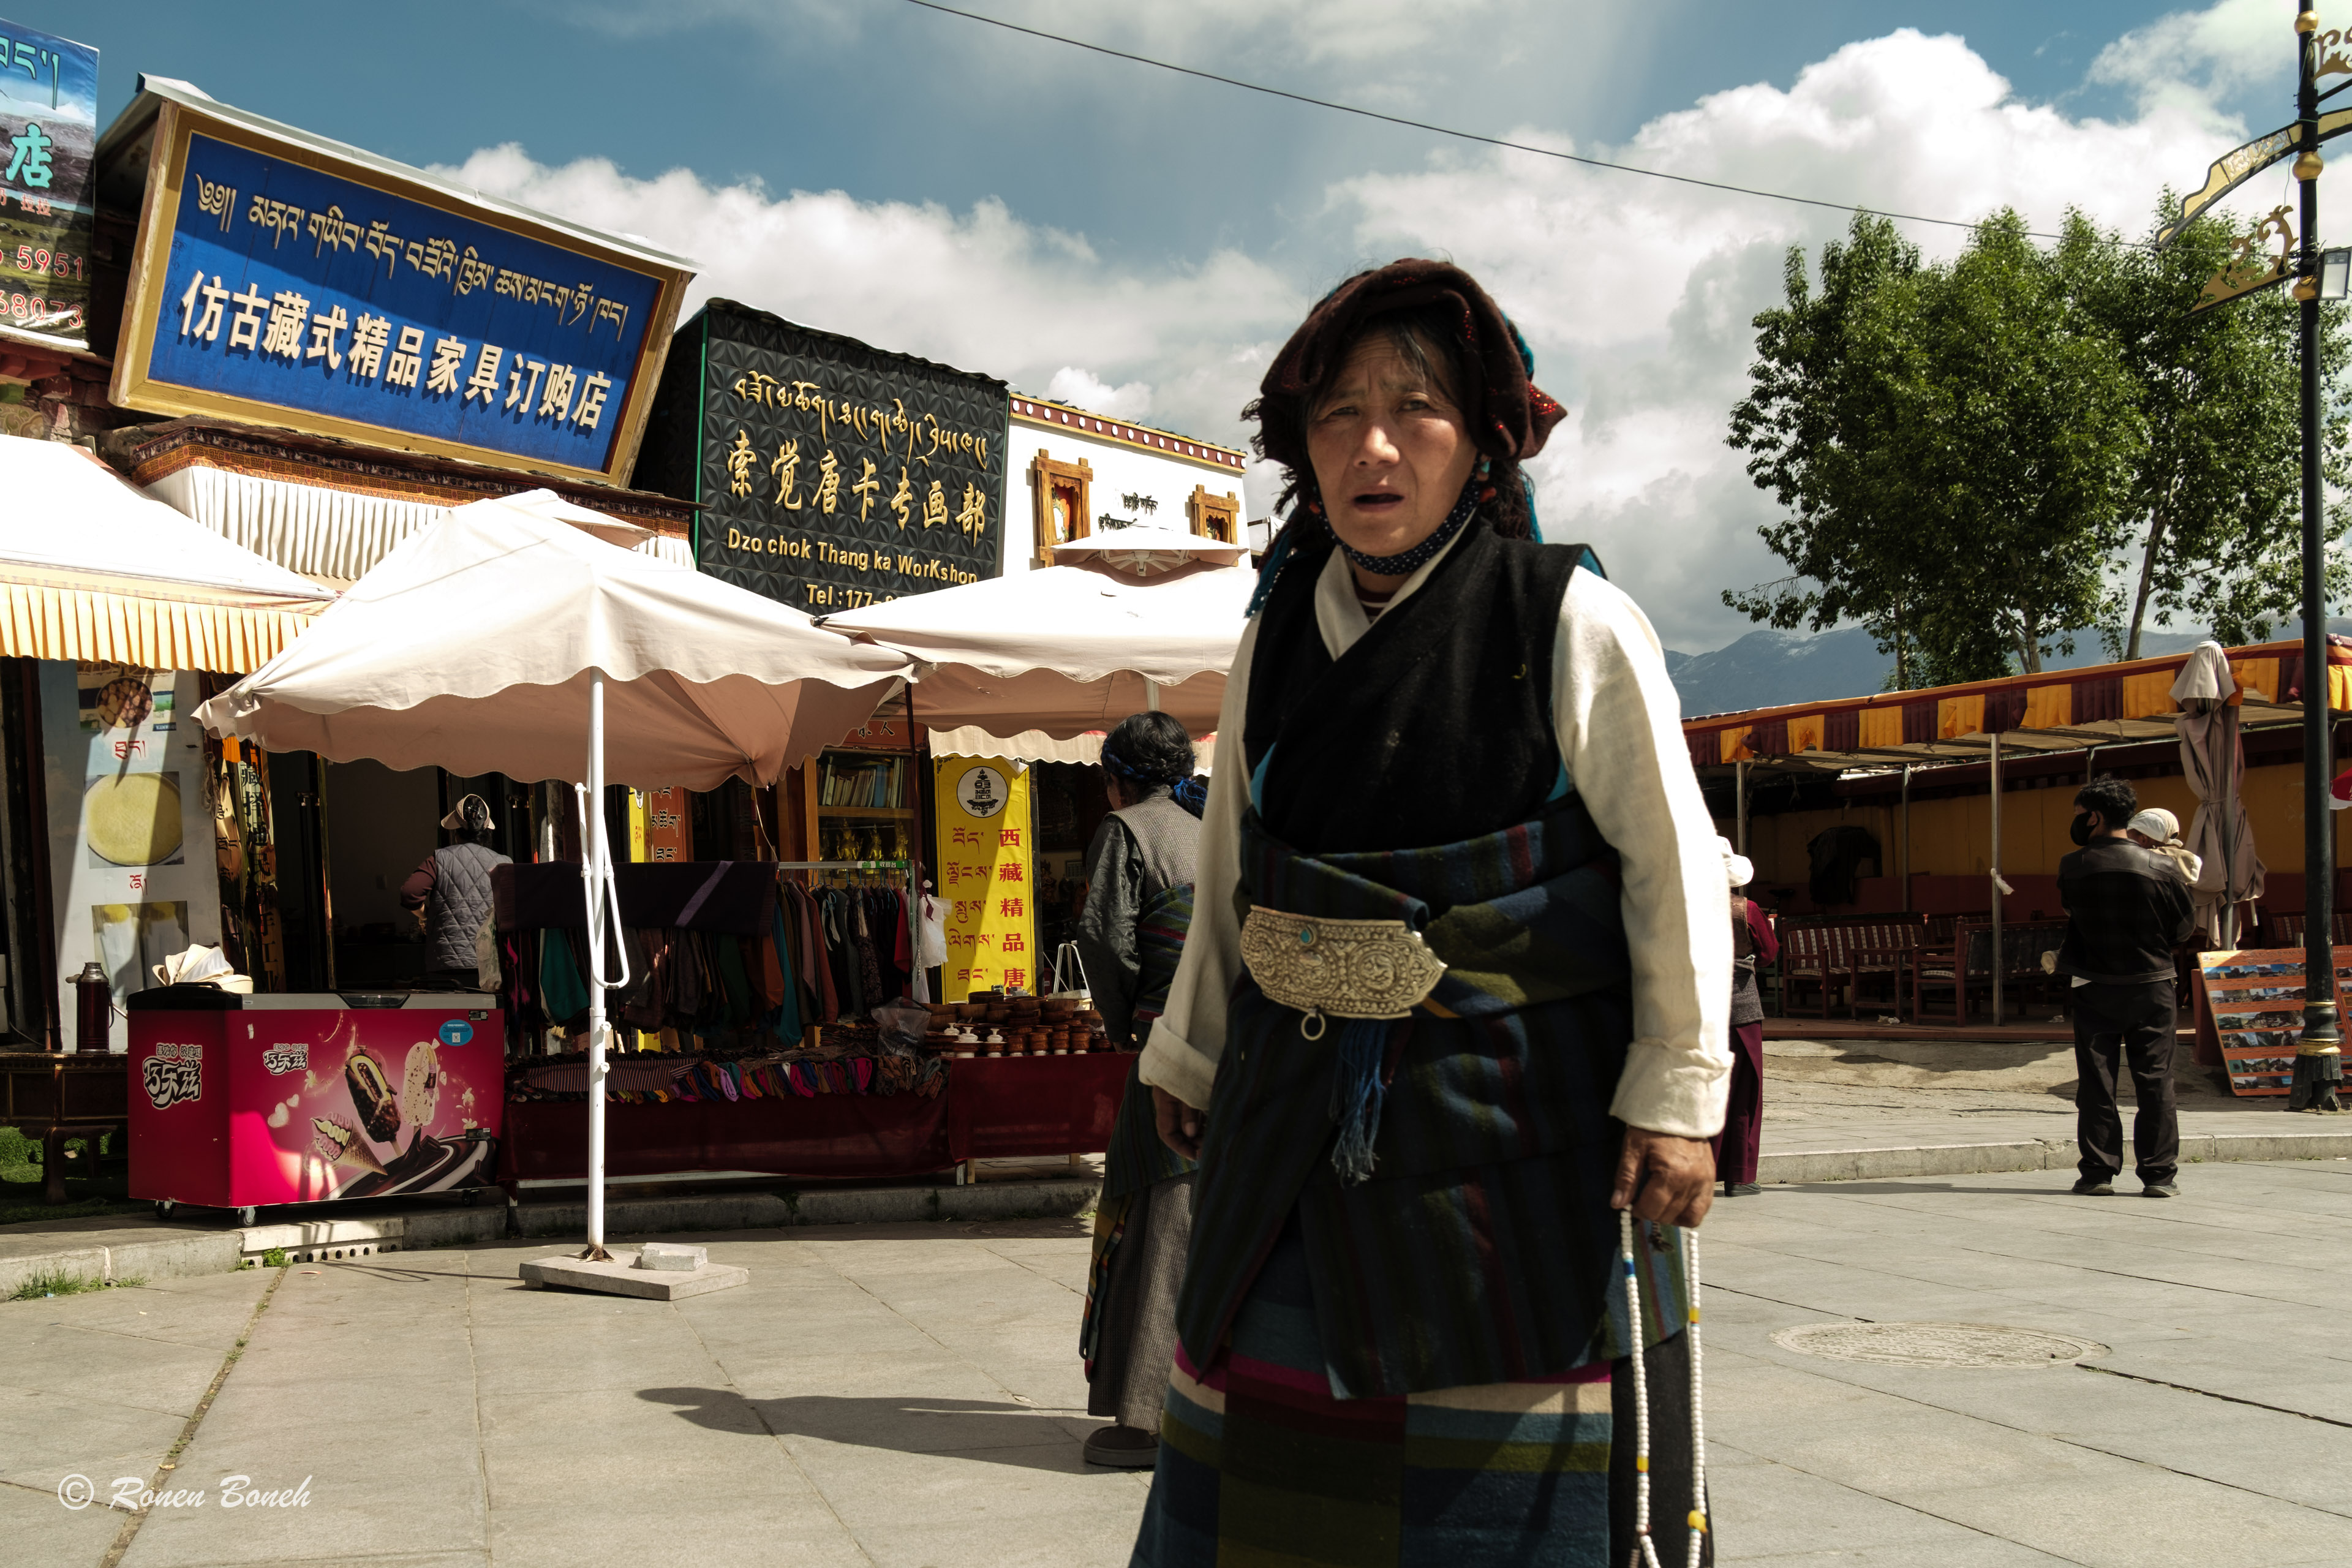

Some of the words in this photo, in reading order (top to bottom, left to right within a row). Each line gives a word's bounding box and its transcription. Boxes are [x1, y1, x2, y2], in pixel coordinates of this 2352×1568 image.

[6, 123, 54, 189] 店
[17, 245, 82, 281] 5951
[181, 270, 612, 430] 仿古藏式精品家具订购店
[728, 528, 763, 552] Dzo
[767, 535, 812, 559] chok
[817, 541, 869, 571] Thang
[873, 550, 891, 570] ka
